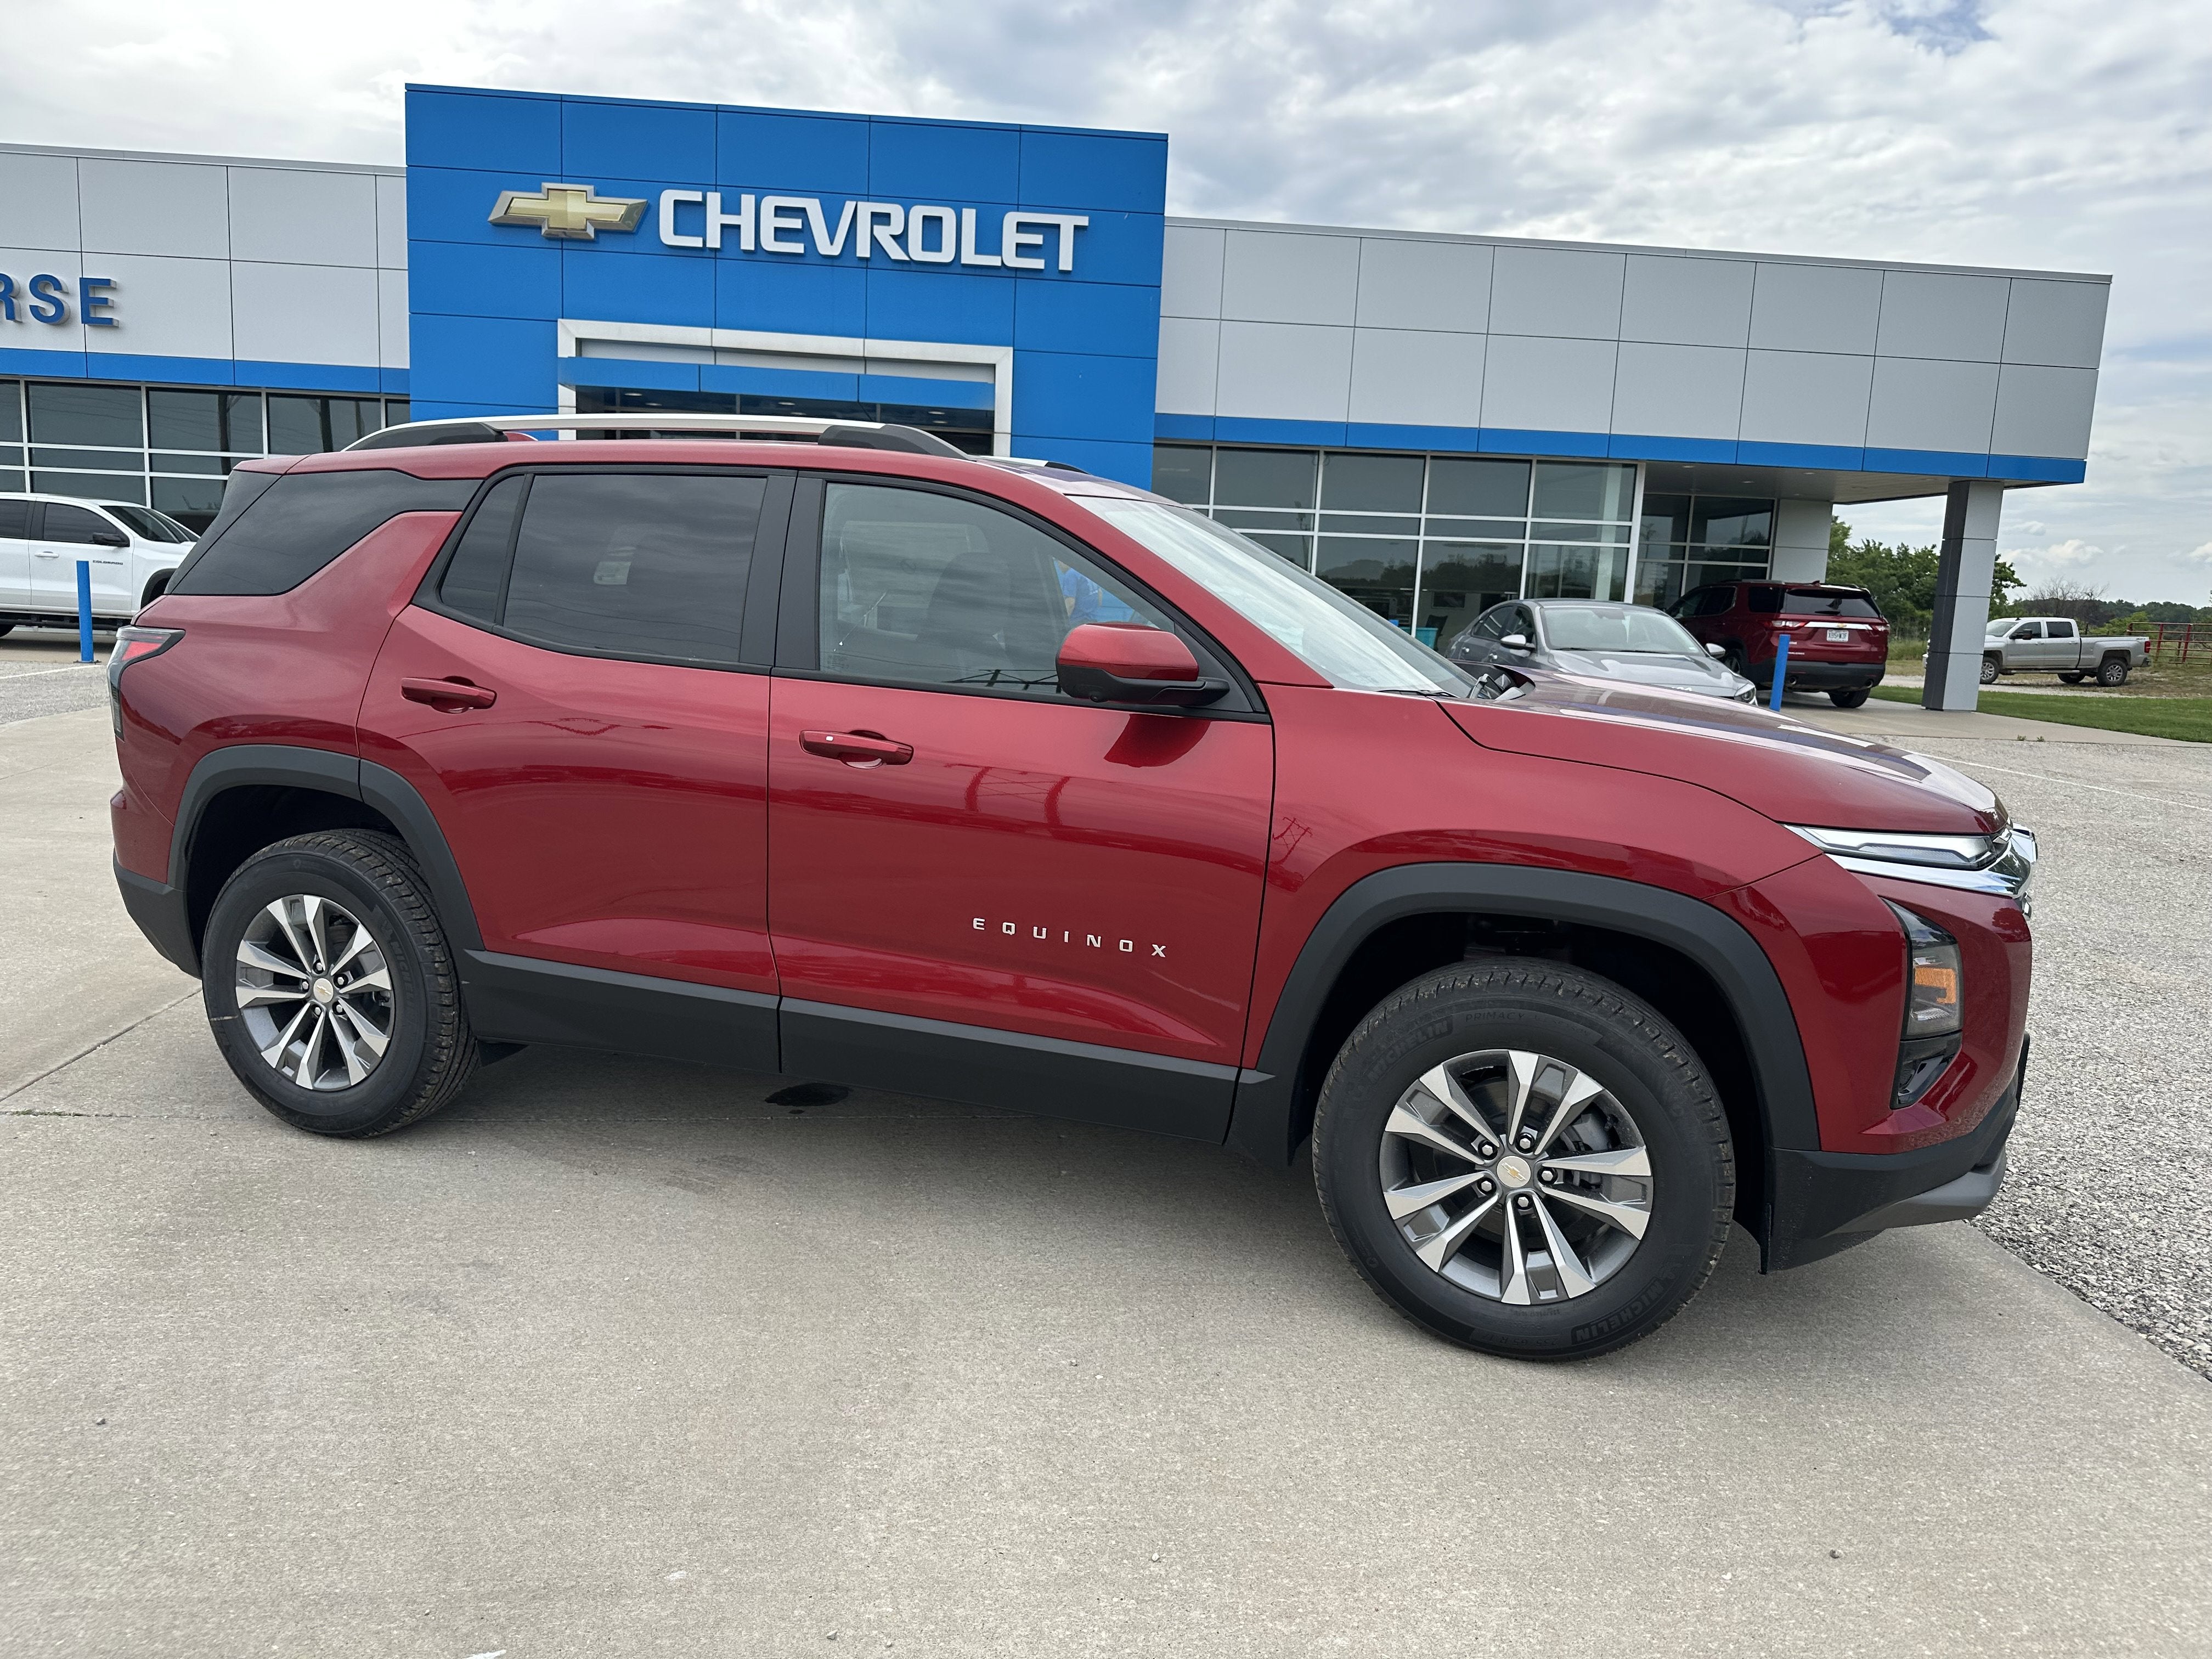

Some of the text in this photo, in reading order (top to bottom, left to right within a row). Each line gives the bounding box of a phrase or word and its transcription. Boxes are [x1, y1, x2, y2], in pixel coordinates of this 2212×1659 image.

[659, 189, 1089, 271] CHEVROLET
[973, 917, 1166, 958] EQUINOX
[1575, 1280, 1664, 1342] MICHELIN
